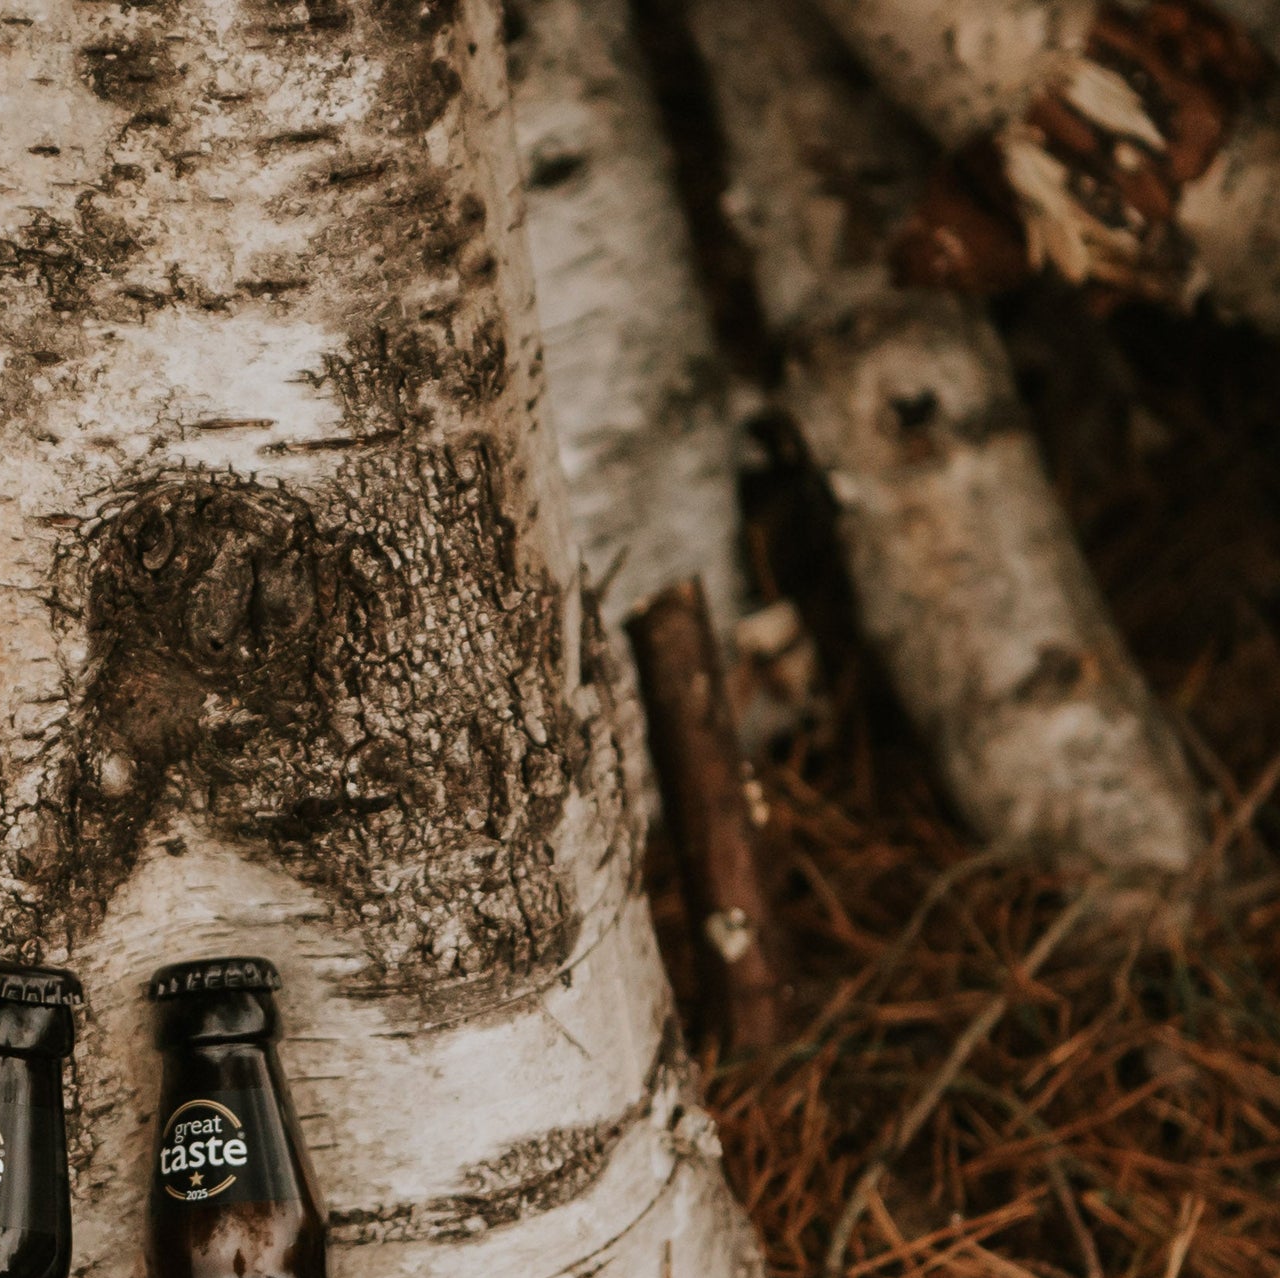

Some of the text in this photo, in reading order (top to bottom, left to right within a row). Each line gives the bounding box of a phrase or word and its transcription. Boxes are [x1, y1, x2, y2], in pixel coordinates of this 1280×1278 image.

[175, 1115, 223, 1143] great
[160, 1136, 247, 1174] taste
[186, 1189, 208, 1200] 2025
